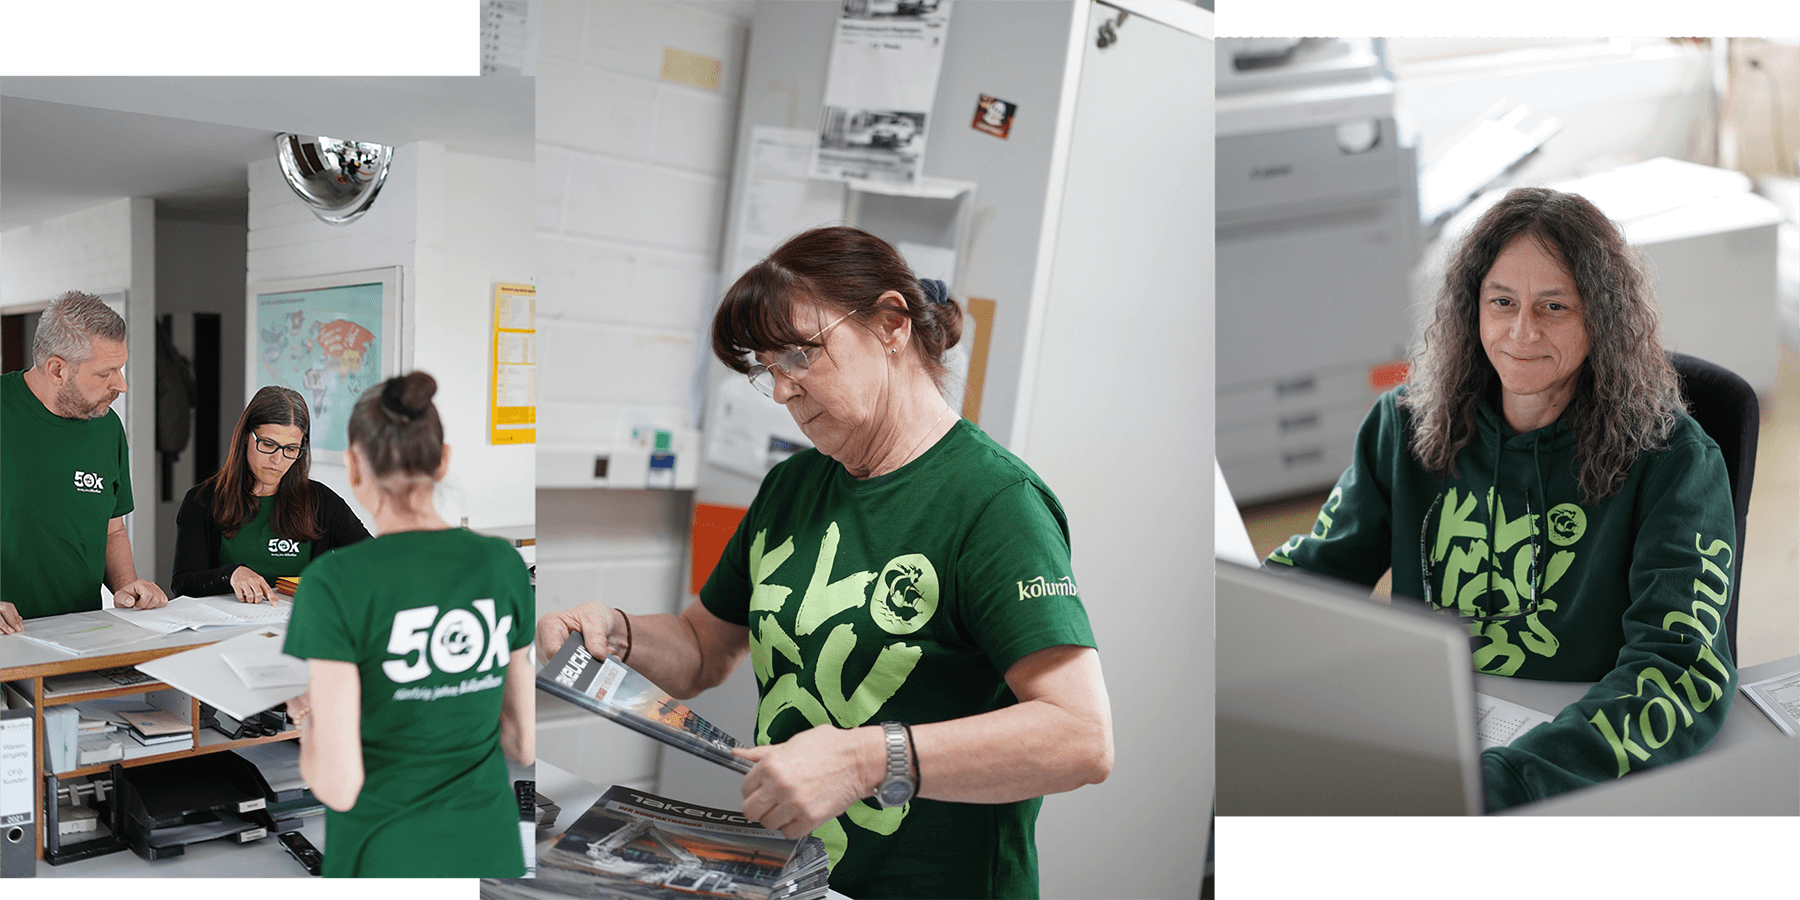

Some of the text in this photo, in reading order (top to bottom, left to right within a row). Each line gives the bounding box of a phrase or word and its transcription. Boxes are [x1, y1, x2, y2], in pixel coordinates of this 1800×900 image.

[1016, 575, 1079, 601] kolumb
[555, 644, 592, 688] AKEUCHI
[630, 793, 752, 824] TAKEUC
